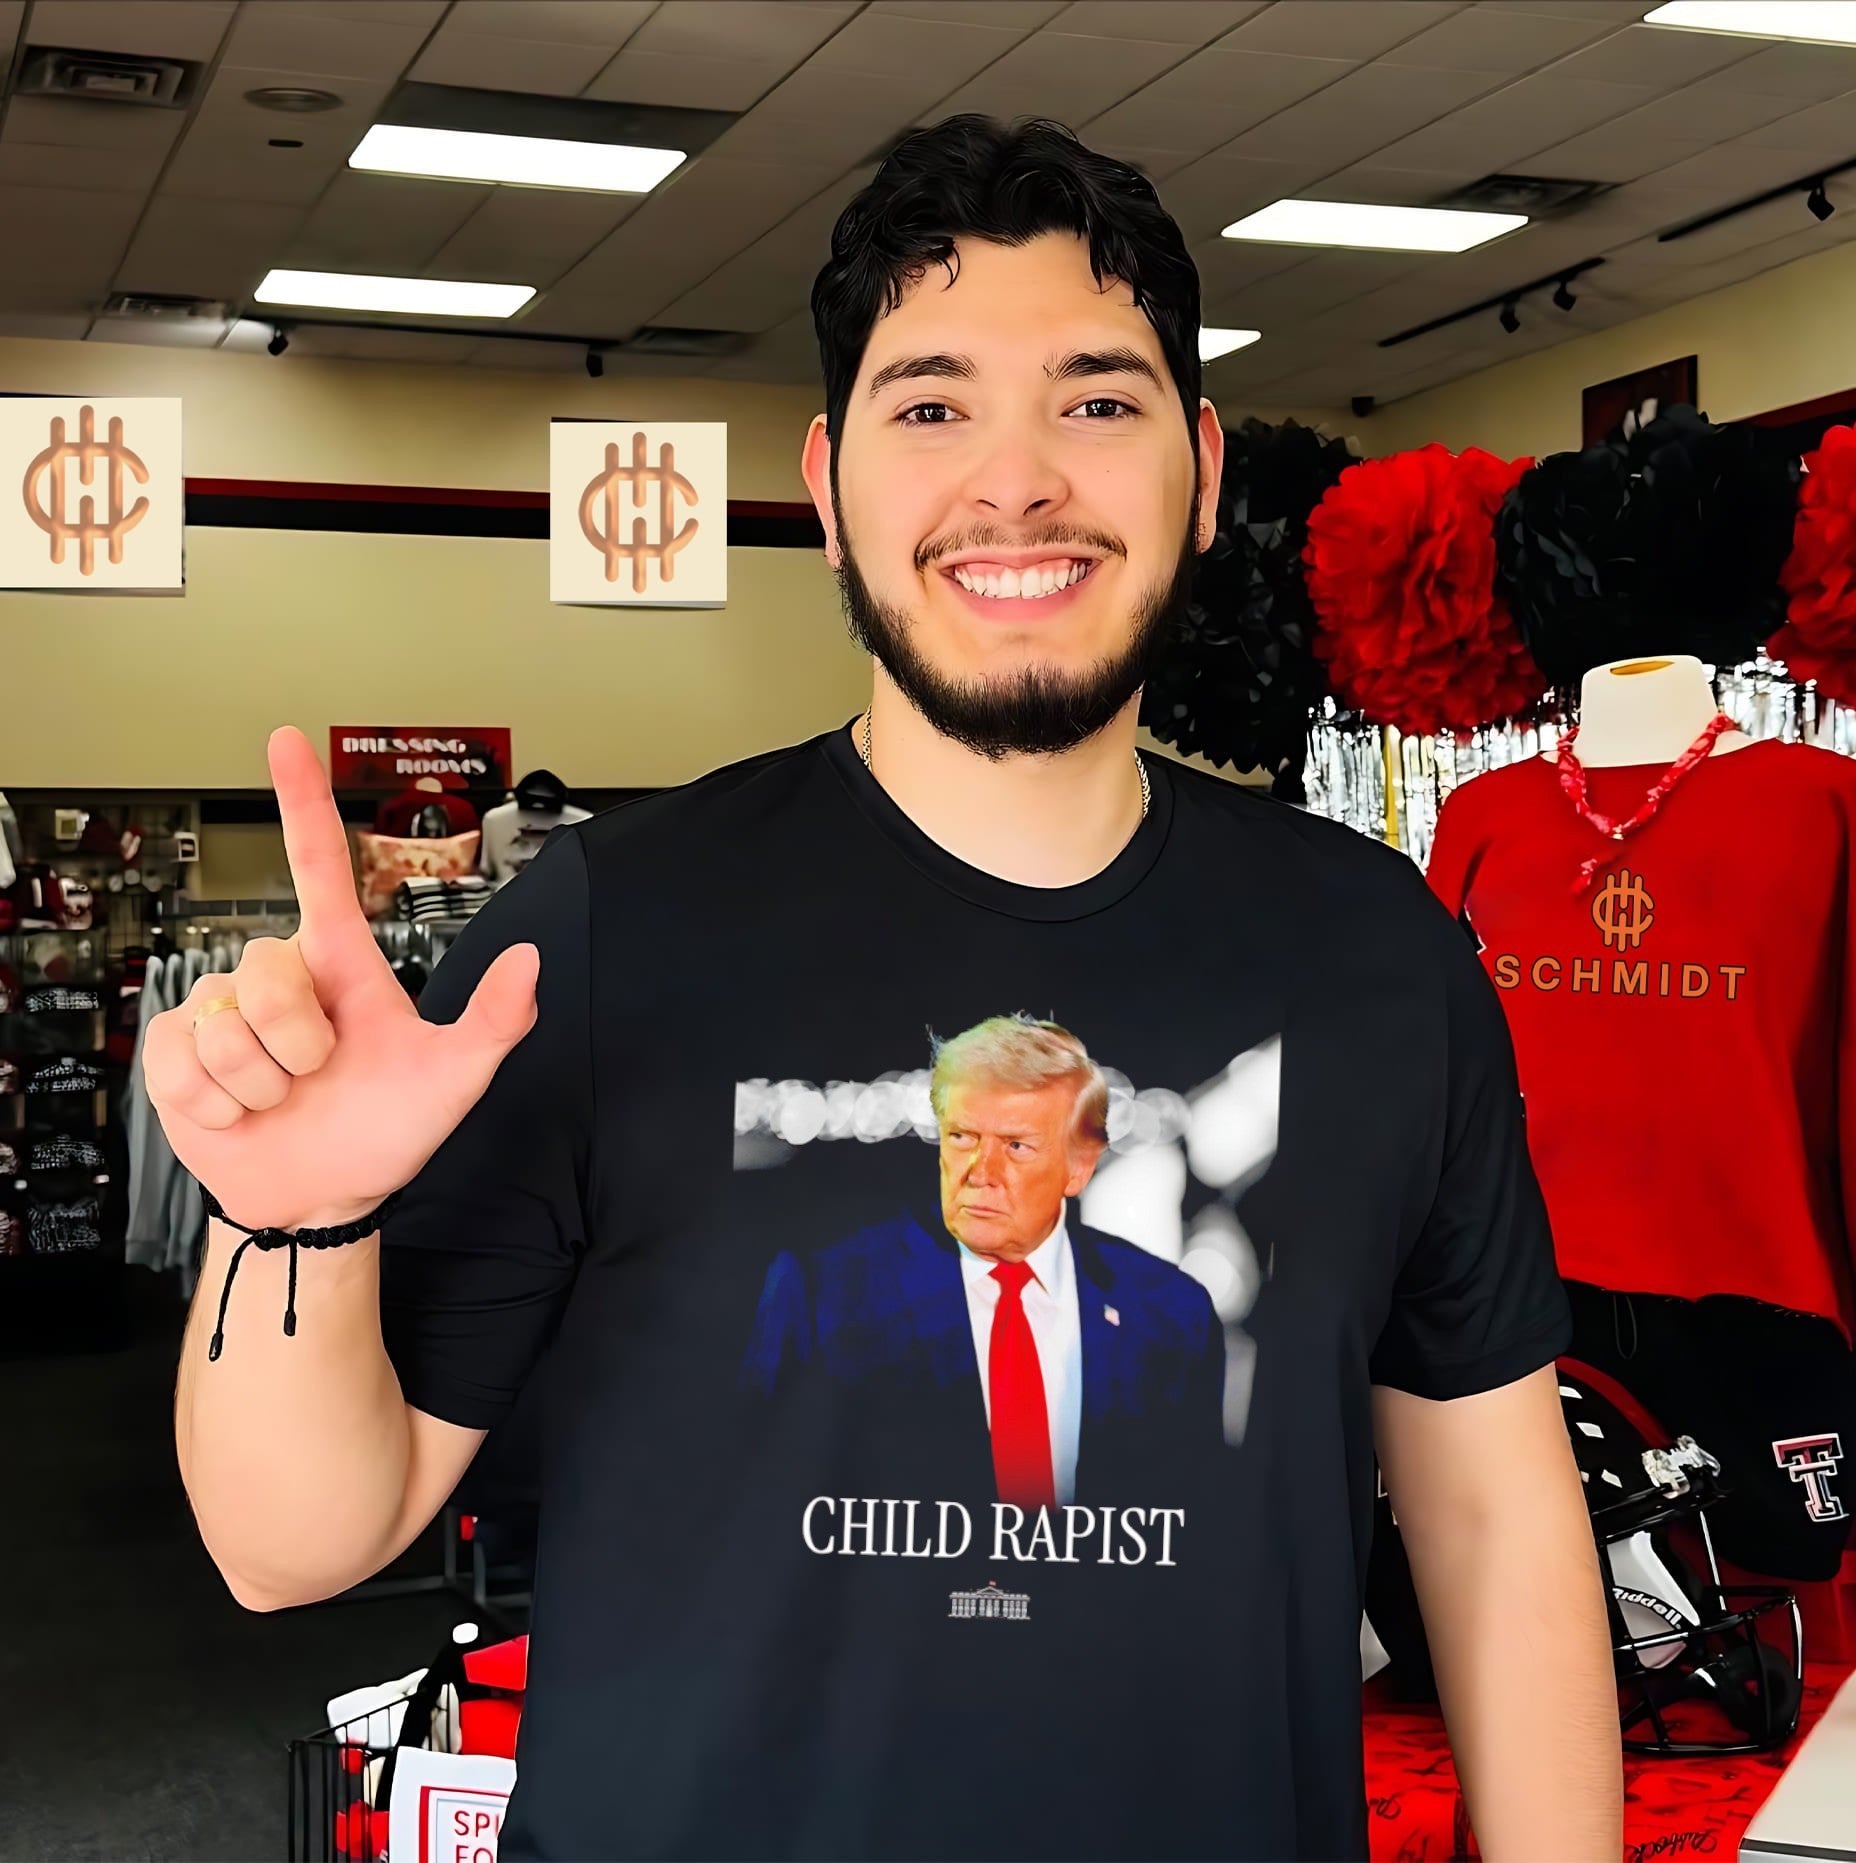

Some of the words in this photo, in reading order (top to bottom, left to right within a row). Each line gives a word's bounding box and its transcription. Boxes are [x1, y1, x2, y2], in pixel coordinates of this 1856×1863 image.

[396, 758, 487, 775] ROOMS
[1494, 954, 1747, 1000] SCHMIDT
[802, 1496, 972, 1558] CHILD
[988, 1502, 1185, 1566] RAPIST
